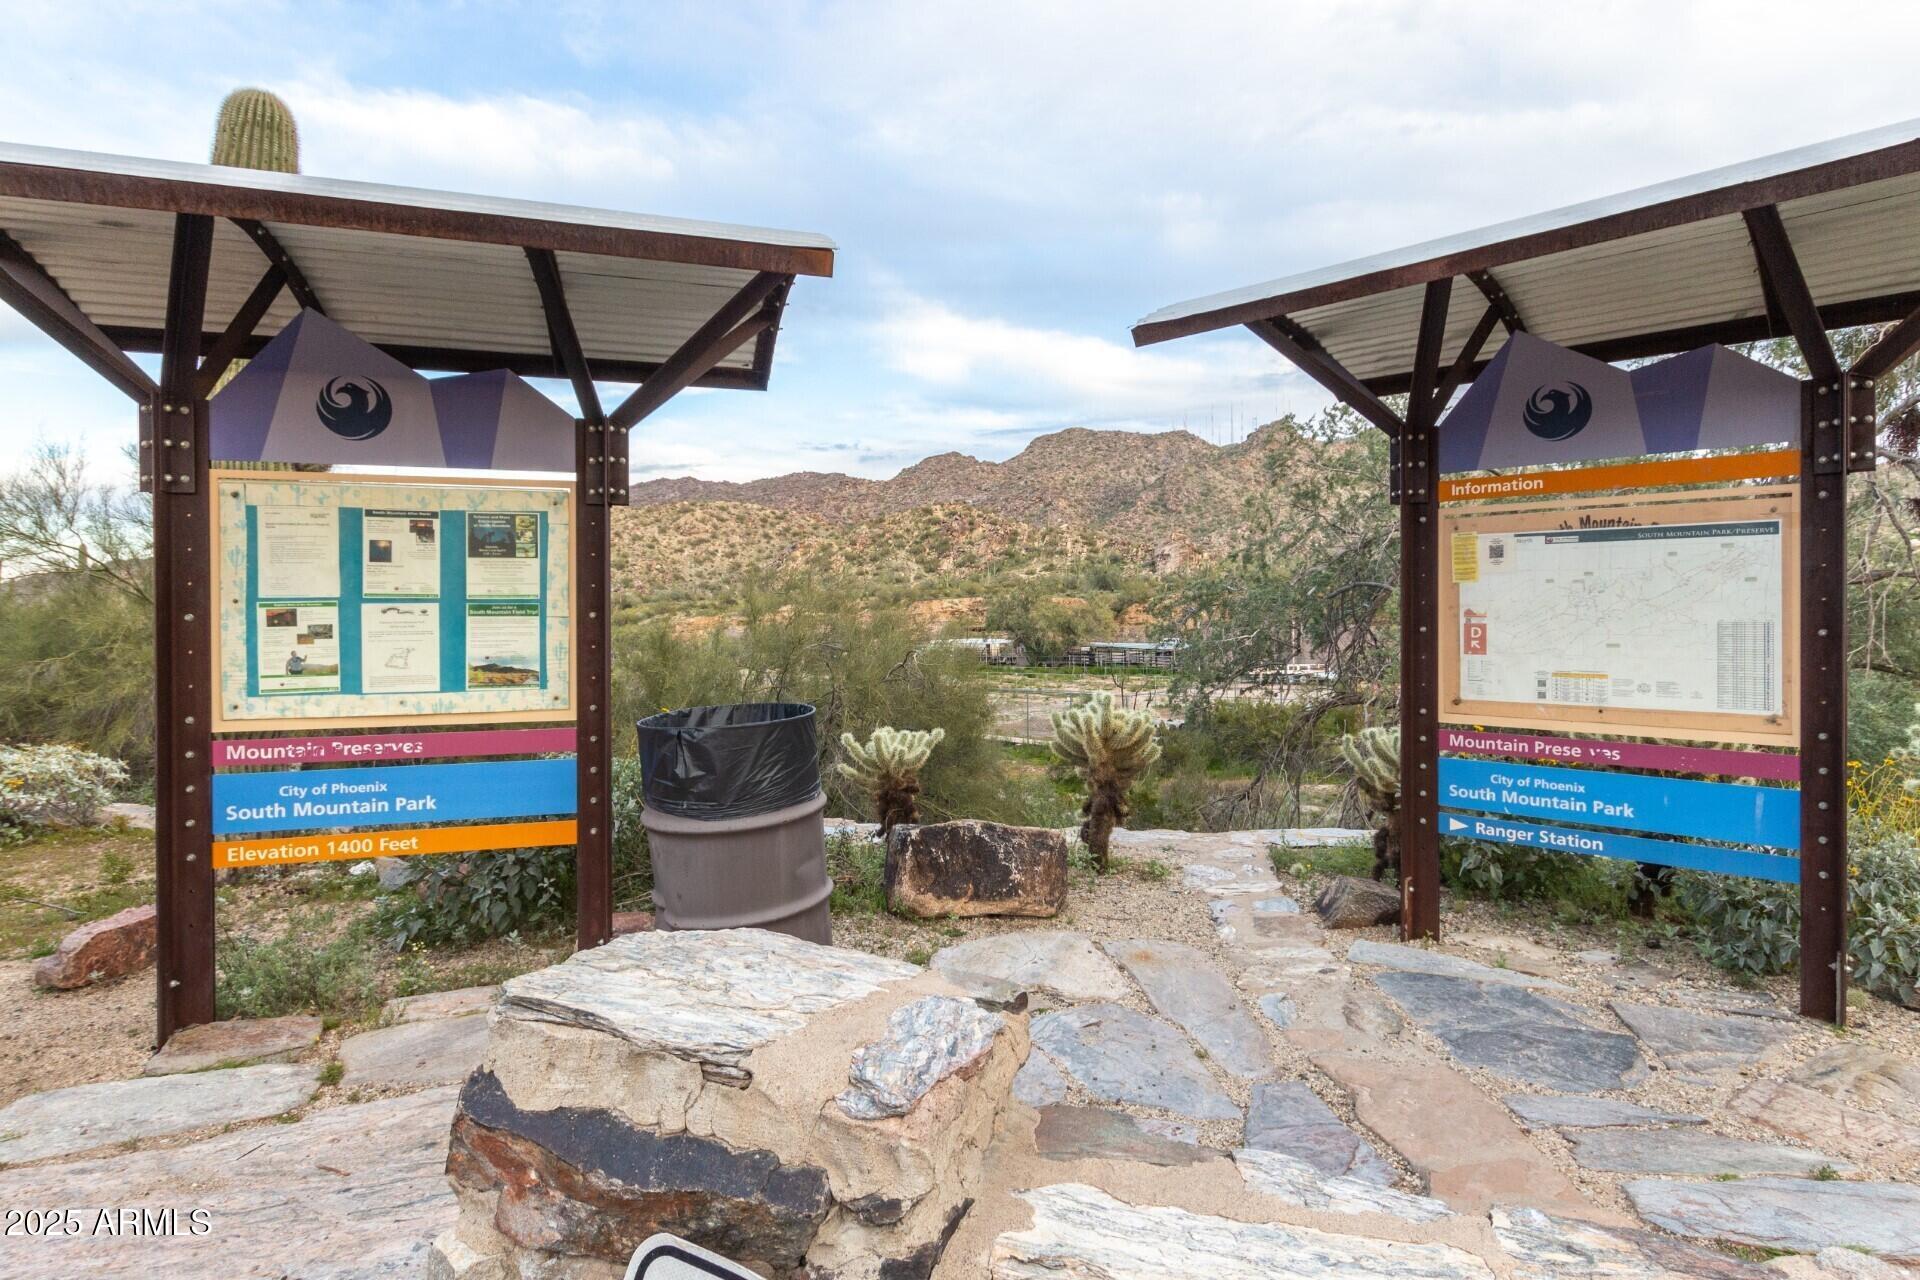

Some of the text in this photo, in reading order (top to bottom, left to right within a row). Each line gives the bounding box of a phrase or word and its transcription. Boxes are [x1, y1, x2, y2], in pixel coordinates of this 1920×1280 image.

[1451, 477, 1544, 496] Information
[1449, 734, 1621, 761] Mountain Preseves
[279, 781, 388, 798] City of Phoenix
[1490, 774, 1585, 793] City of Phoenix
[226, 795, 437, 821] South Mountain Park
[1449, 784, 1634, 818] South Mountain Park
[227, 836, 419, 862] Elevation 1400 Feet
[1475, 822, 1603, 851] Ranger Station
